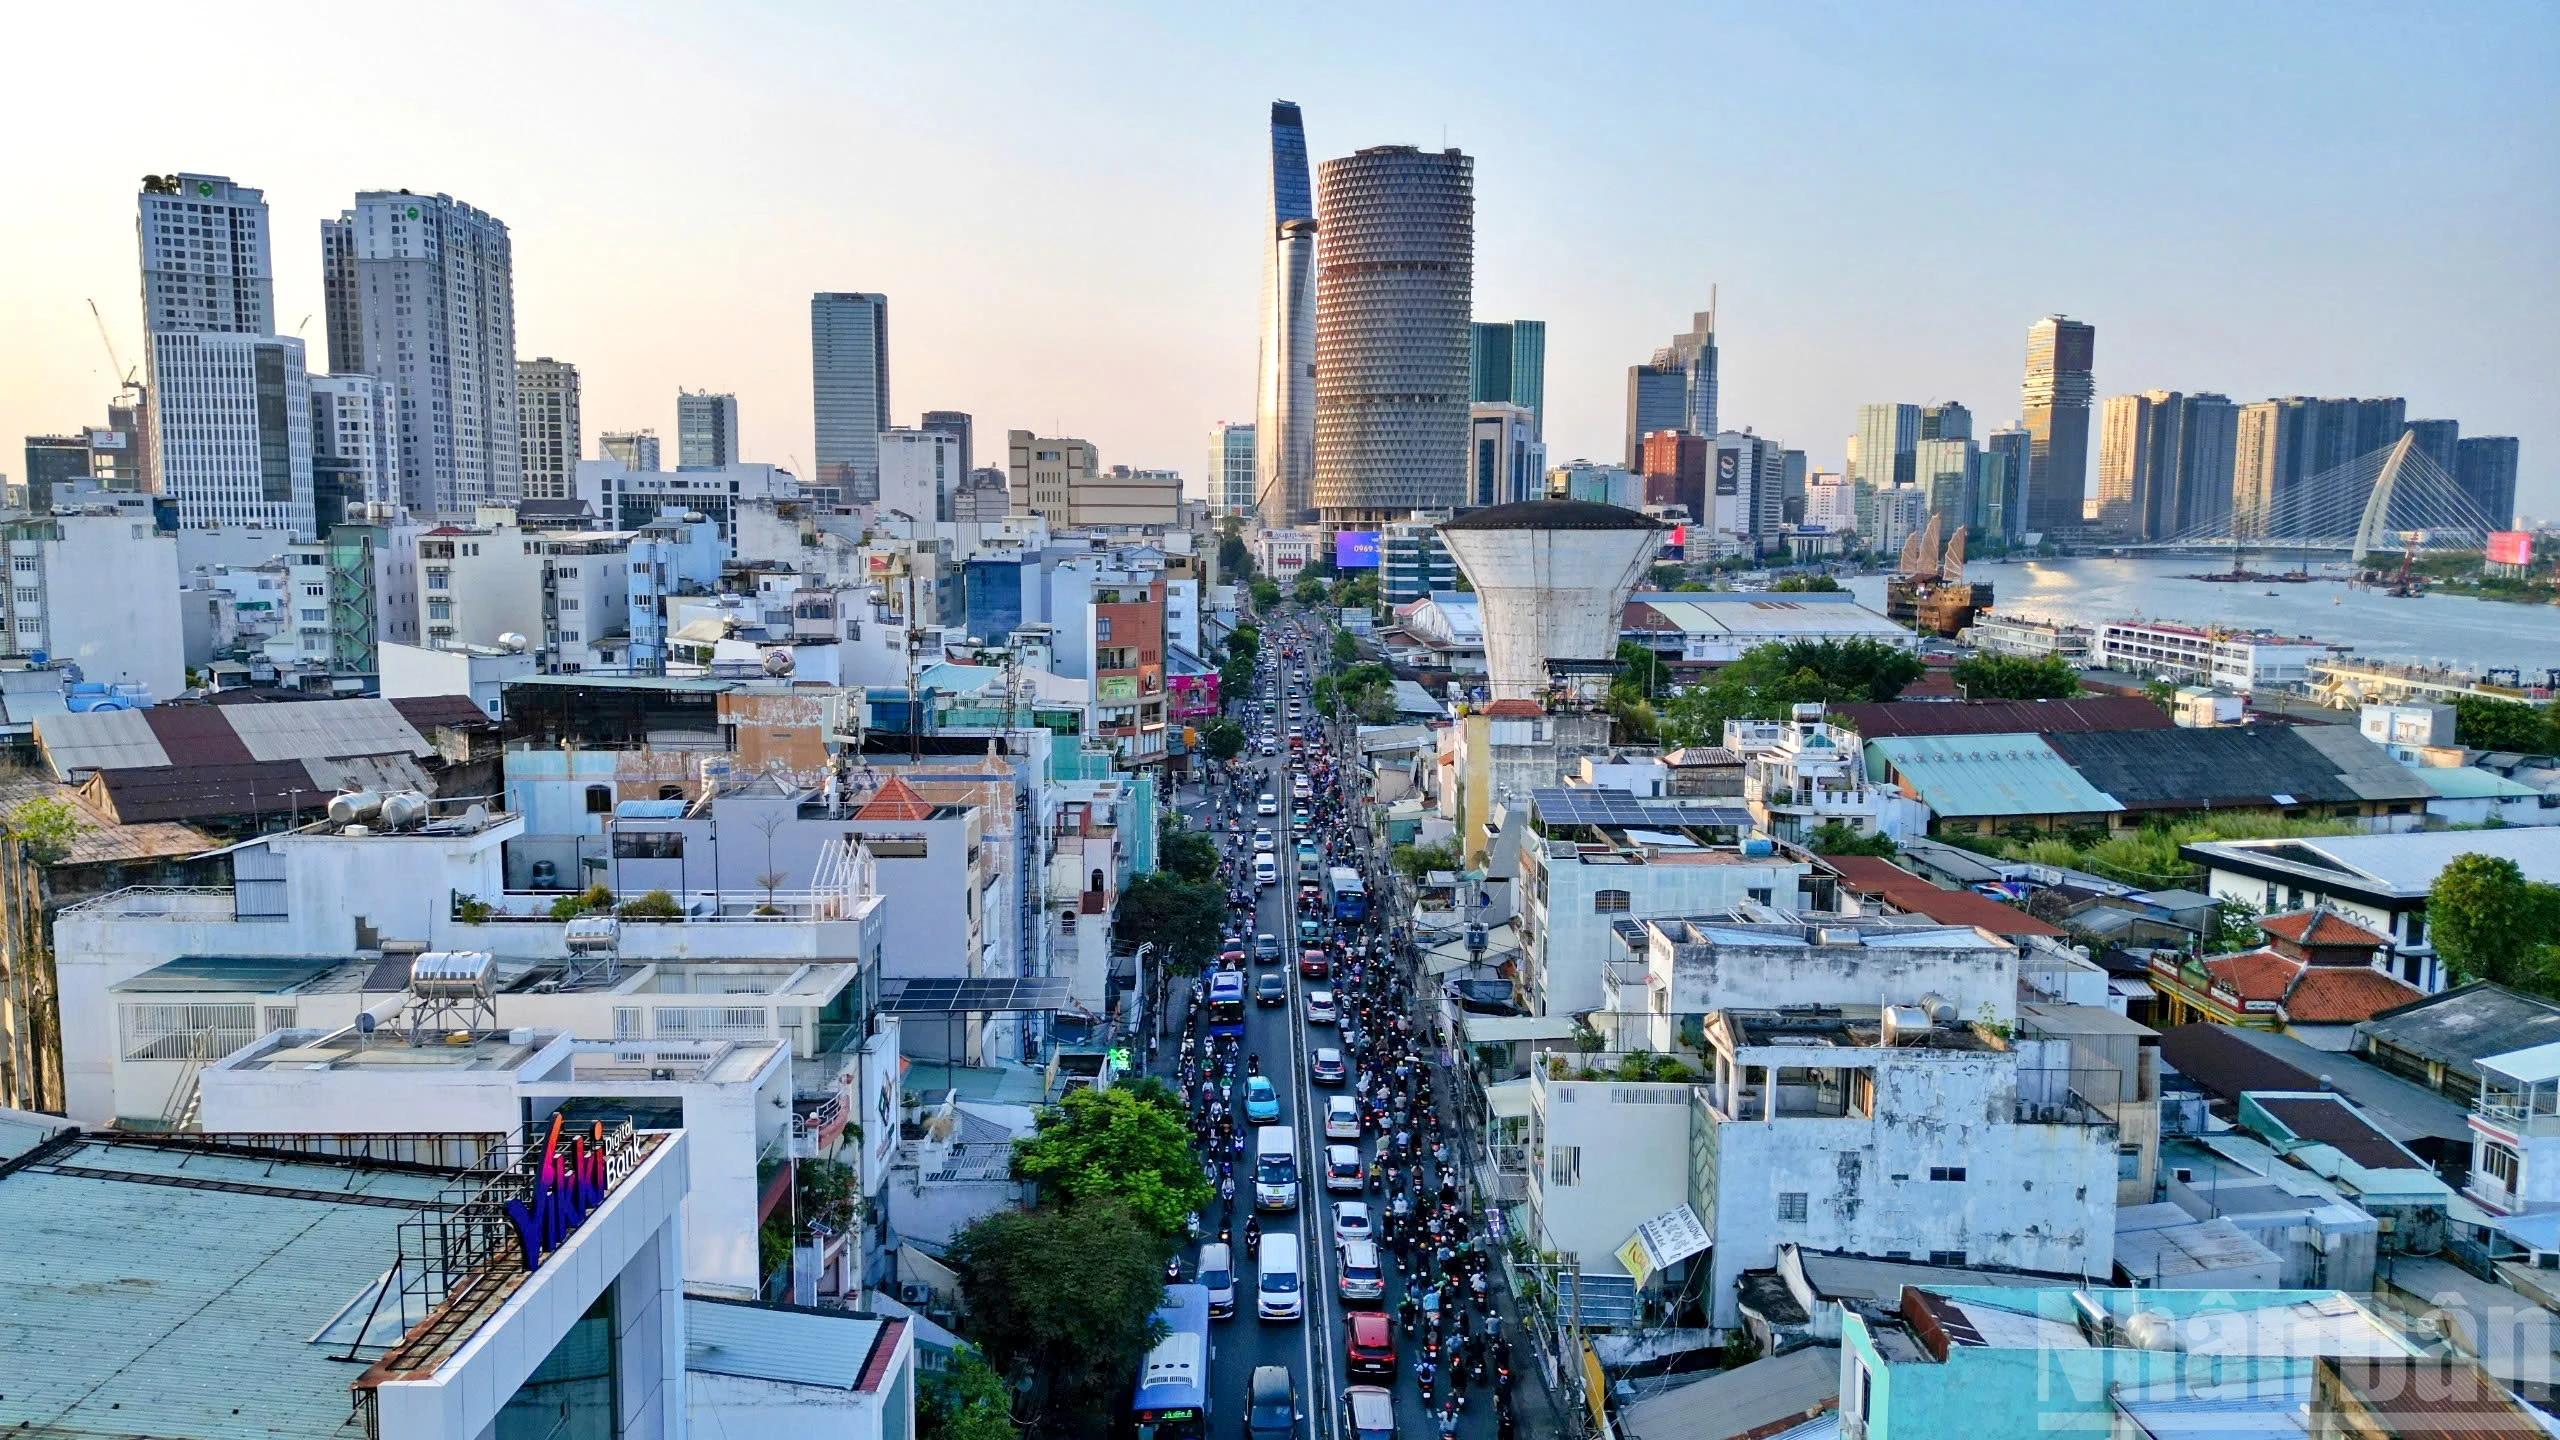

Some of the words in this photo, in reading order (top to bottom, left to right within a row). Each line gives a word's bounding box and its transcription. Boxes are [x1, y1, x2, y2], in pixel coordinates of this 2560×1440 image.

[605, 1115, 633, 1156] Digital
[605, 1133, 642, 1190] Bank
[504, 1112, 605, 1272] Vikki
